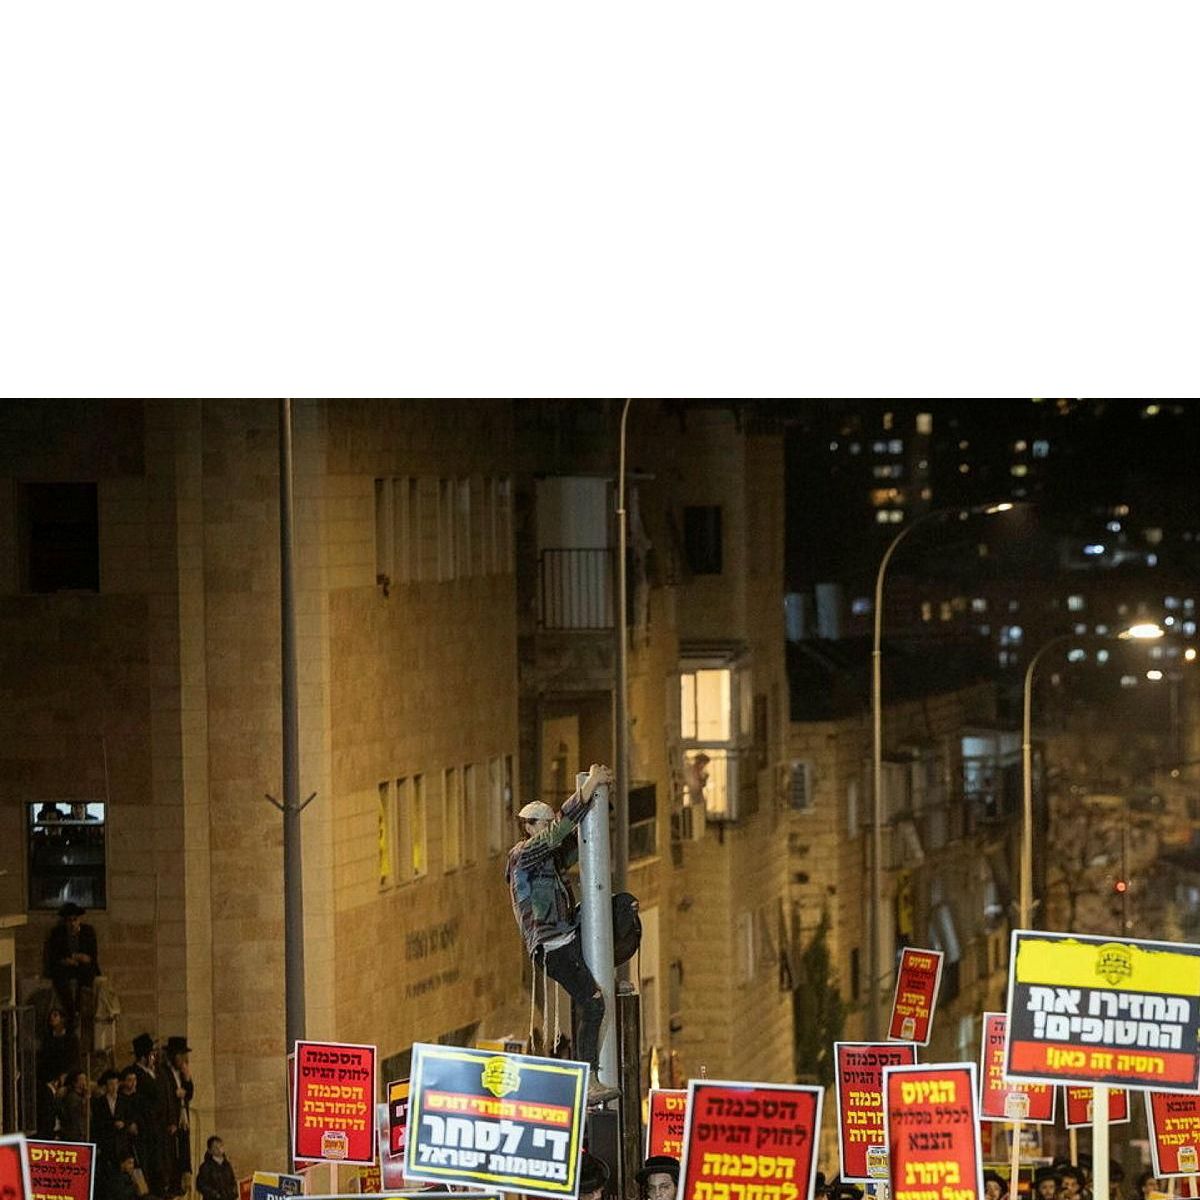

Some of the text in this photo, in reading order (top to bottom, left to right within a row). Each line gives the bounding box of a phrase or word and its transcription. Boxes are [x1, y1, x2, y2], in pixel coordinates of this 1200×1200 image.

[1027, 987, 1190, 1022] תחזירו את
[1033, 1011, 1182, 1049] החטופים!
[306, 1050, 361, 1065] הסכמה
[846, 1052, 902, 1066] הסכמה
[1046, 1047, 1165, 1074] רוסיה זה כאן!
[302, 1066, 369, 1082] לחוק הגיוס
[843, 1072, 878, 1085] הגיוס
[307, 1083, 363, 1100] הסכמה
[901, 1079, 955, 1104] הגיוס
[303, 1100, 367, 1115] להחרבת
[427, 1093, 468, 1111] דורש
[472, 1098, 517, 1116] החרדי
[706, 1096, 797, 1119] הסכמה
[1166, 1101, 1196, 1112] הצבא
[304, 1115, 365, 1130] היהדות
[518, 1104, 570, 1123] הציבור
[891, 1107, 969, 1125] לכלל מסלולי
[422, 1114, 570, 1161] די לסחר
[697, 1122, 807, 1148] לחוק הגיוס
[908, 1132, 953, 1150] הצבא
[1159, 1132, 1190, 1146] יעבור
[31, 1148, 77, 1163] הגיוס
[419, 1143, 568, 1180] בנשמות ישראל
[702, 1152, 796, 1179] הסכמה
[905, 1161, 961, 1185] ביהרג
[33, 1177, 71, 1189] הצבא
